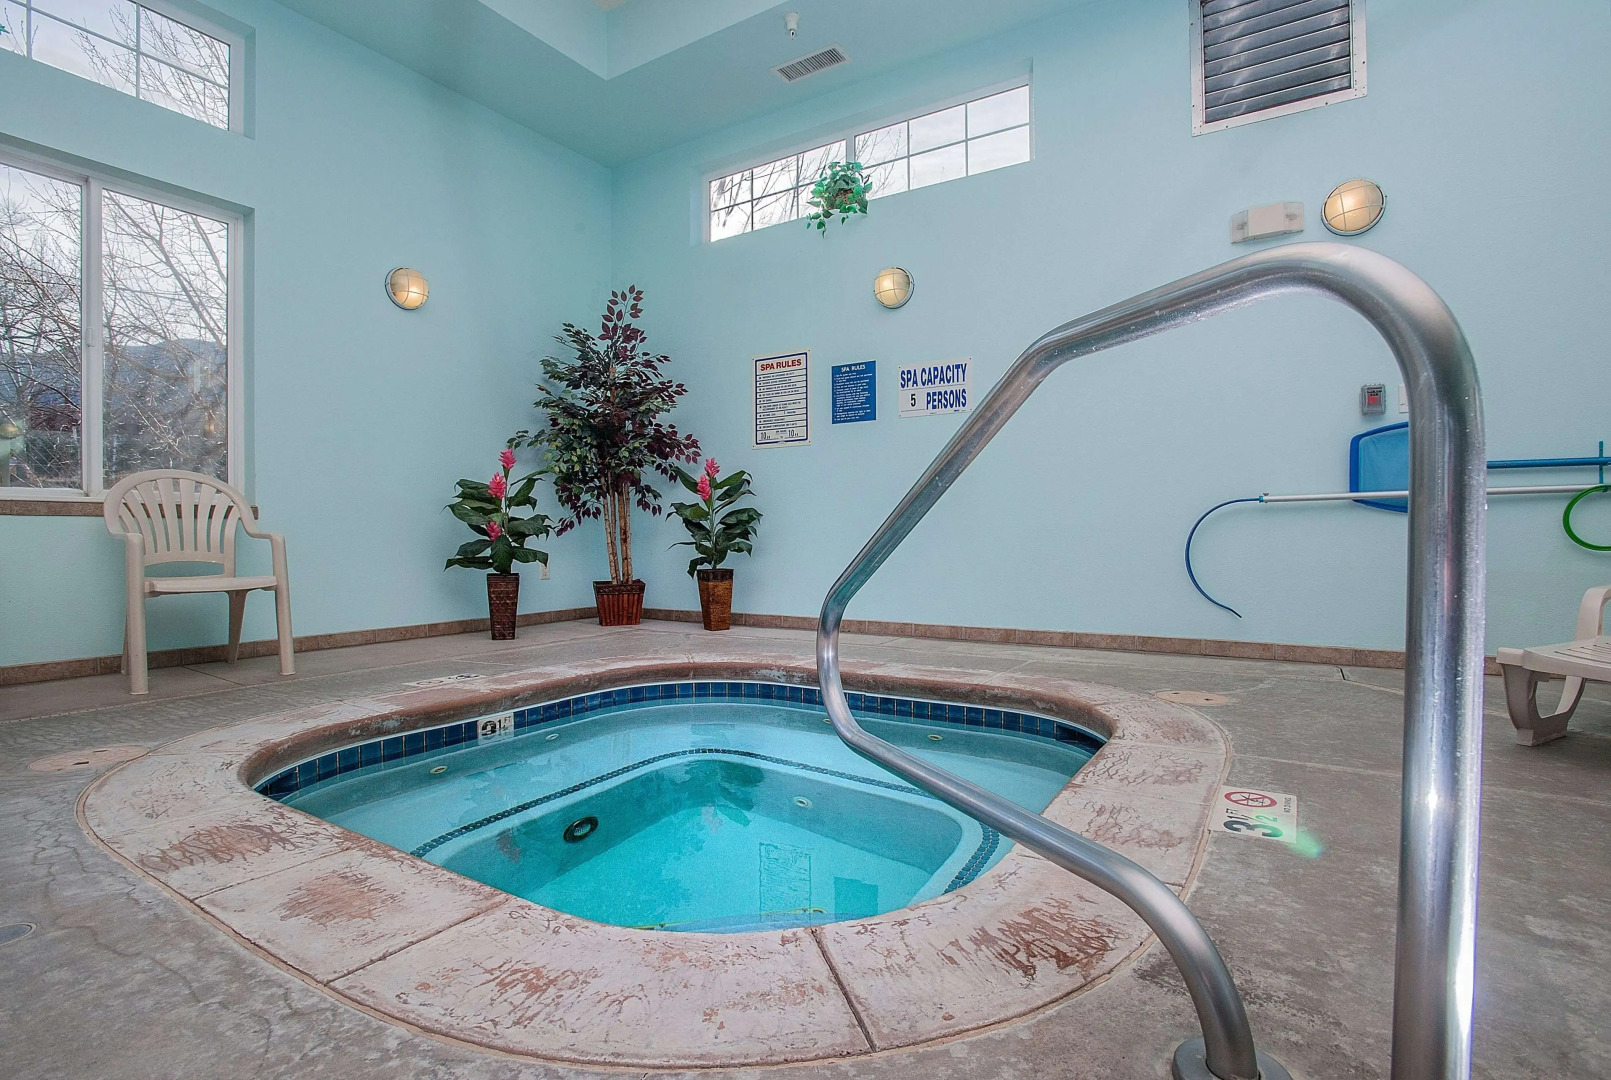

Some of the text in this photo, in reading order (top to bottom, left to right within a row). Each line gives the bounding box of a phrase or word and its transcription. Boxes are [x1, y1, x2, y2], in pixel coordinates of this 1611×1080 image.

[760, 358, 802, 372] SPA RULES
[900, 363, 967, 389] SPA CAPACITY
[910, 388, 967, 410] 5 PERSONS
